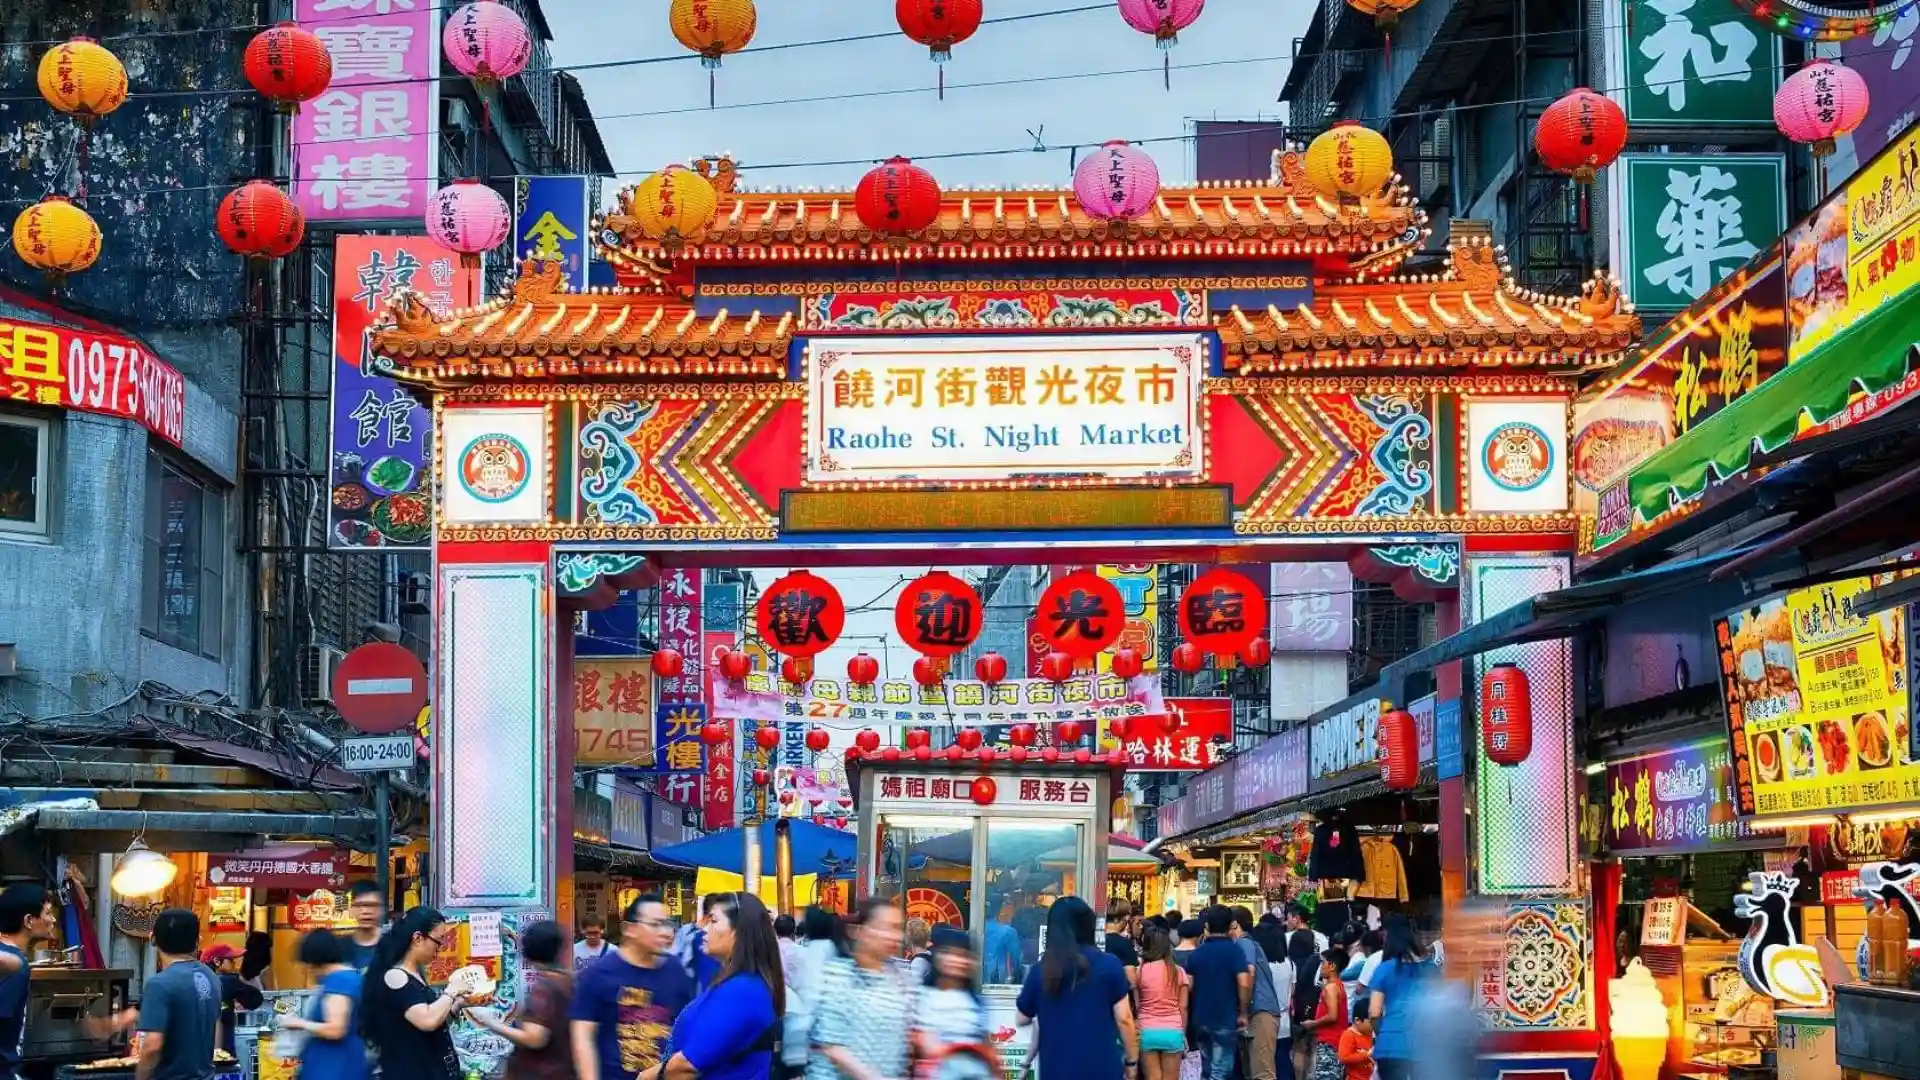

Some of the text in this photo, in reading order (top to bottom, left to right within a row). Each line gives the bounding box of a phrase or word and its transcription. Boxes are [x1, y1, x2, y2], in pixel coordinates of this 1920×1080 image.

[1108, 148, 1126, 203] 天上聖母
[1644, 165, 1761, 299] 藥
[350, 248, 422, 449] 韓館
[832, 363, 1178, 411] 饒河街觀光夜市
[828, 422, 1183, 452] Raohe St. Night Market
[768, 590, 831, 647] 歡
[914, 590, 971, 648] 迎
[1050, 590, 1109, 640] 光
[1185, 588, 1247, 636] 臨
[344, 740, 412, 762] 16:00-24:00
[880, 776, 1091, 803] 媽祖廟口 服務台
[224, 860, 334, 877] 微笑丹丹德國大香腸
